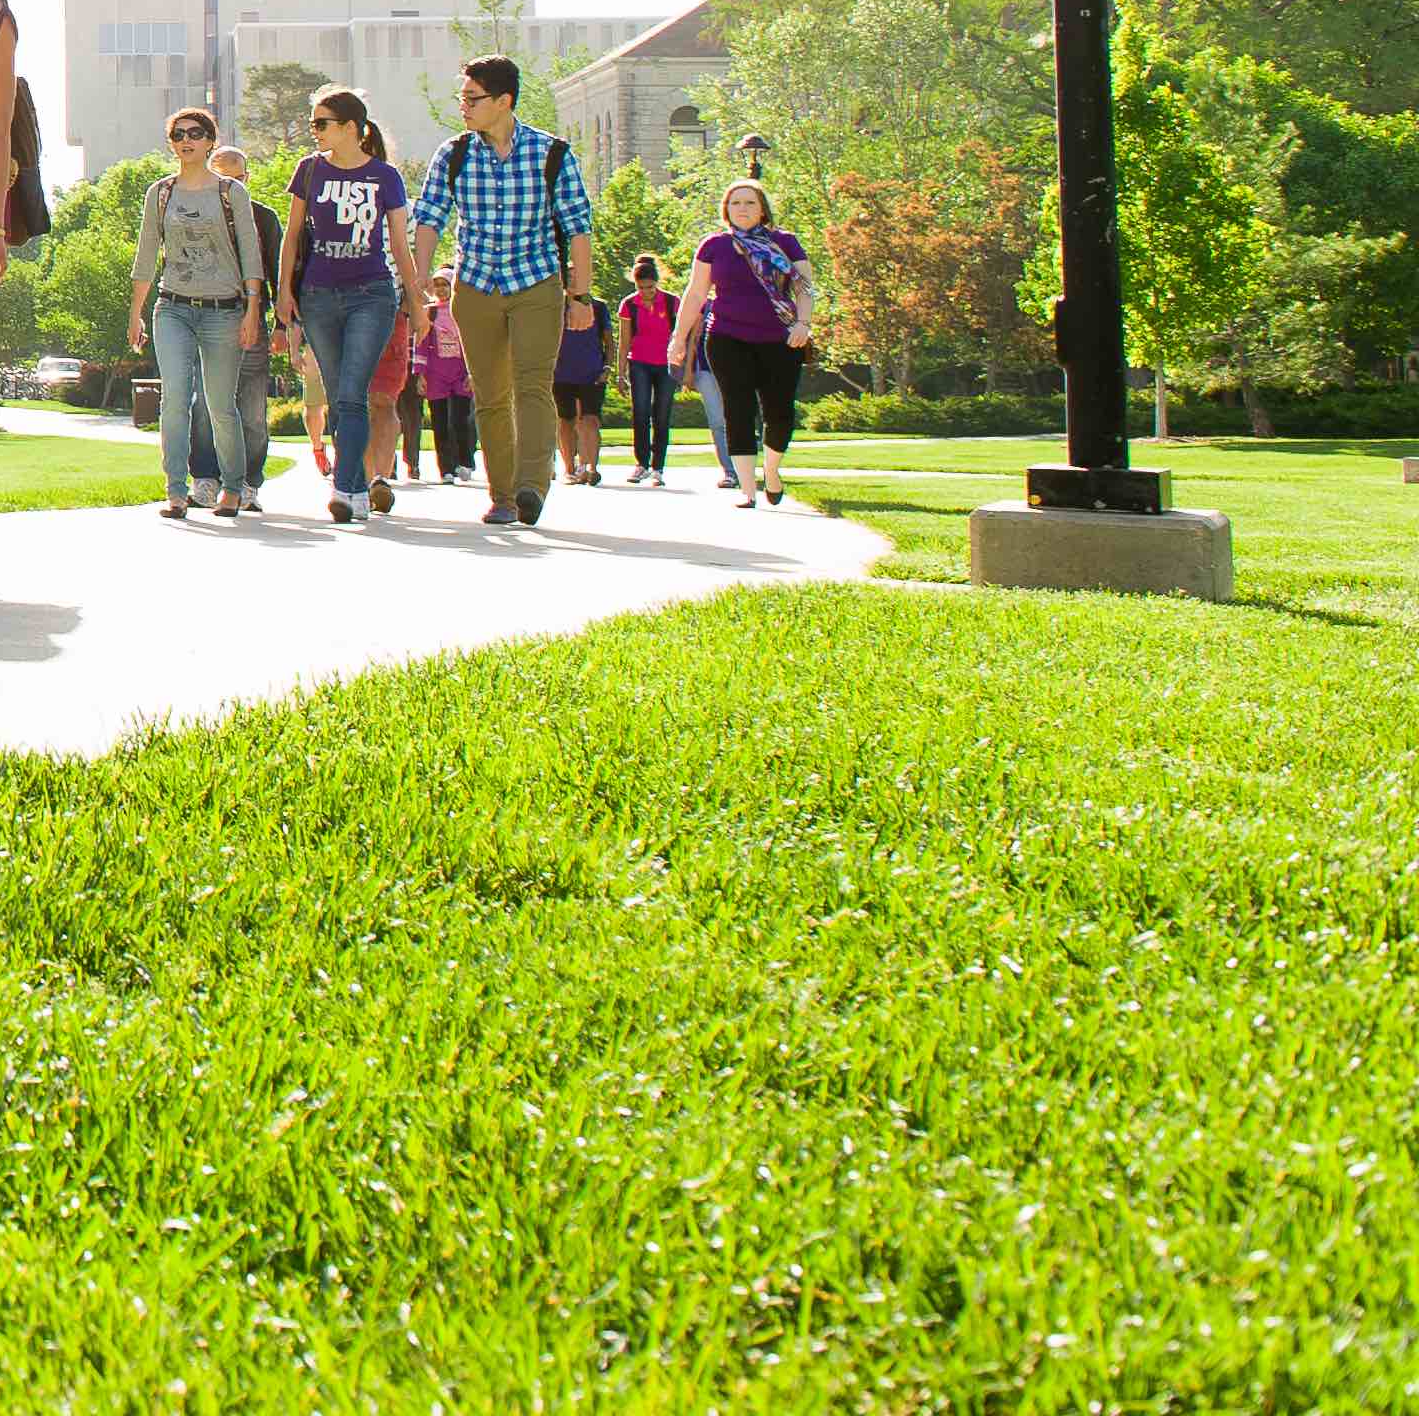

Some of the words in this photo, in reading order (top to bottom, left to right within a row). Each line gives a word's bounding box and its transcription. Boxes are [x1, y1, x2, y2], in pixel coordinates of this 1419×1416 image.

[316, 180, 379, 204] JUST
[337, 201, 377, 225] DO
[351, 222, 374, 248] IT
